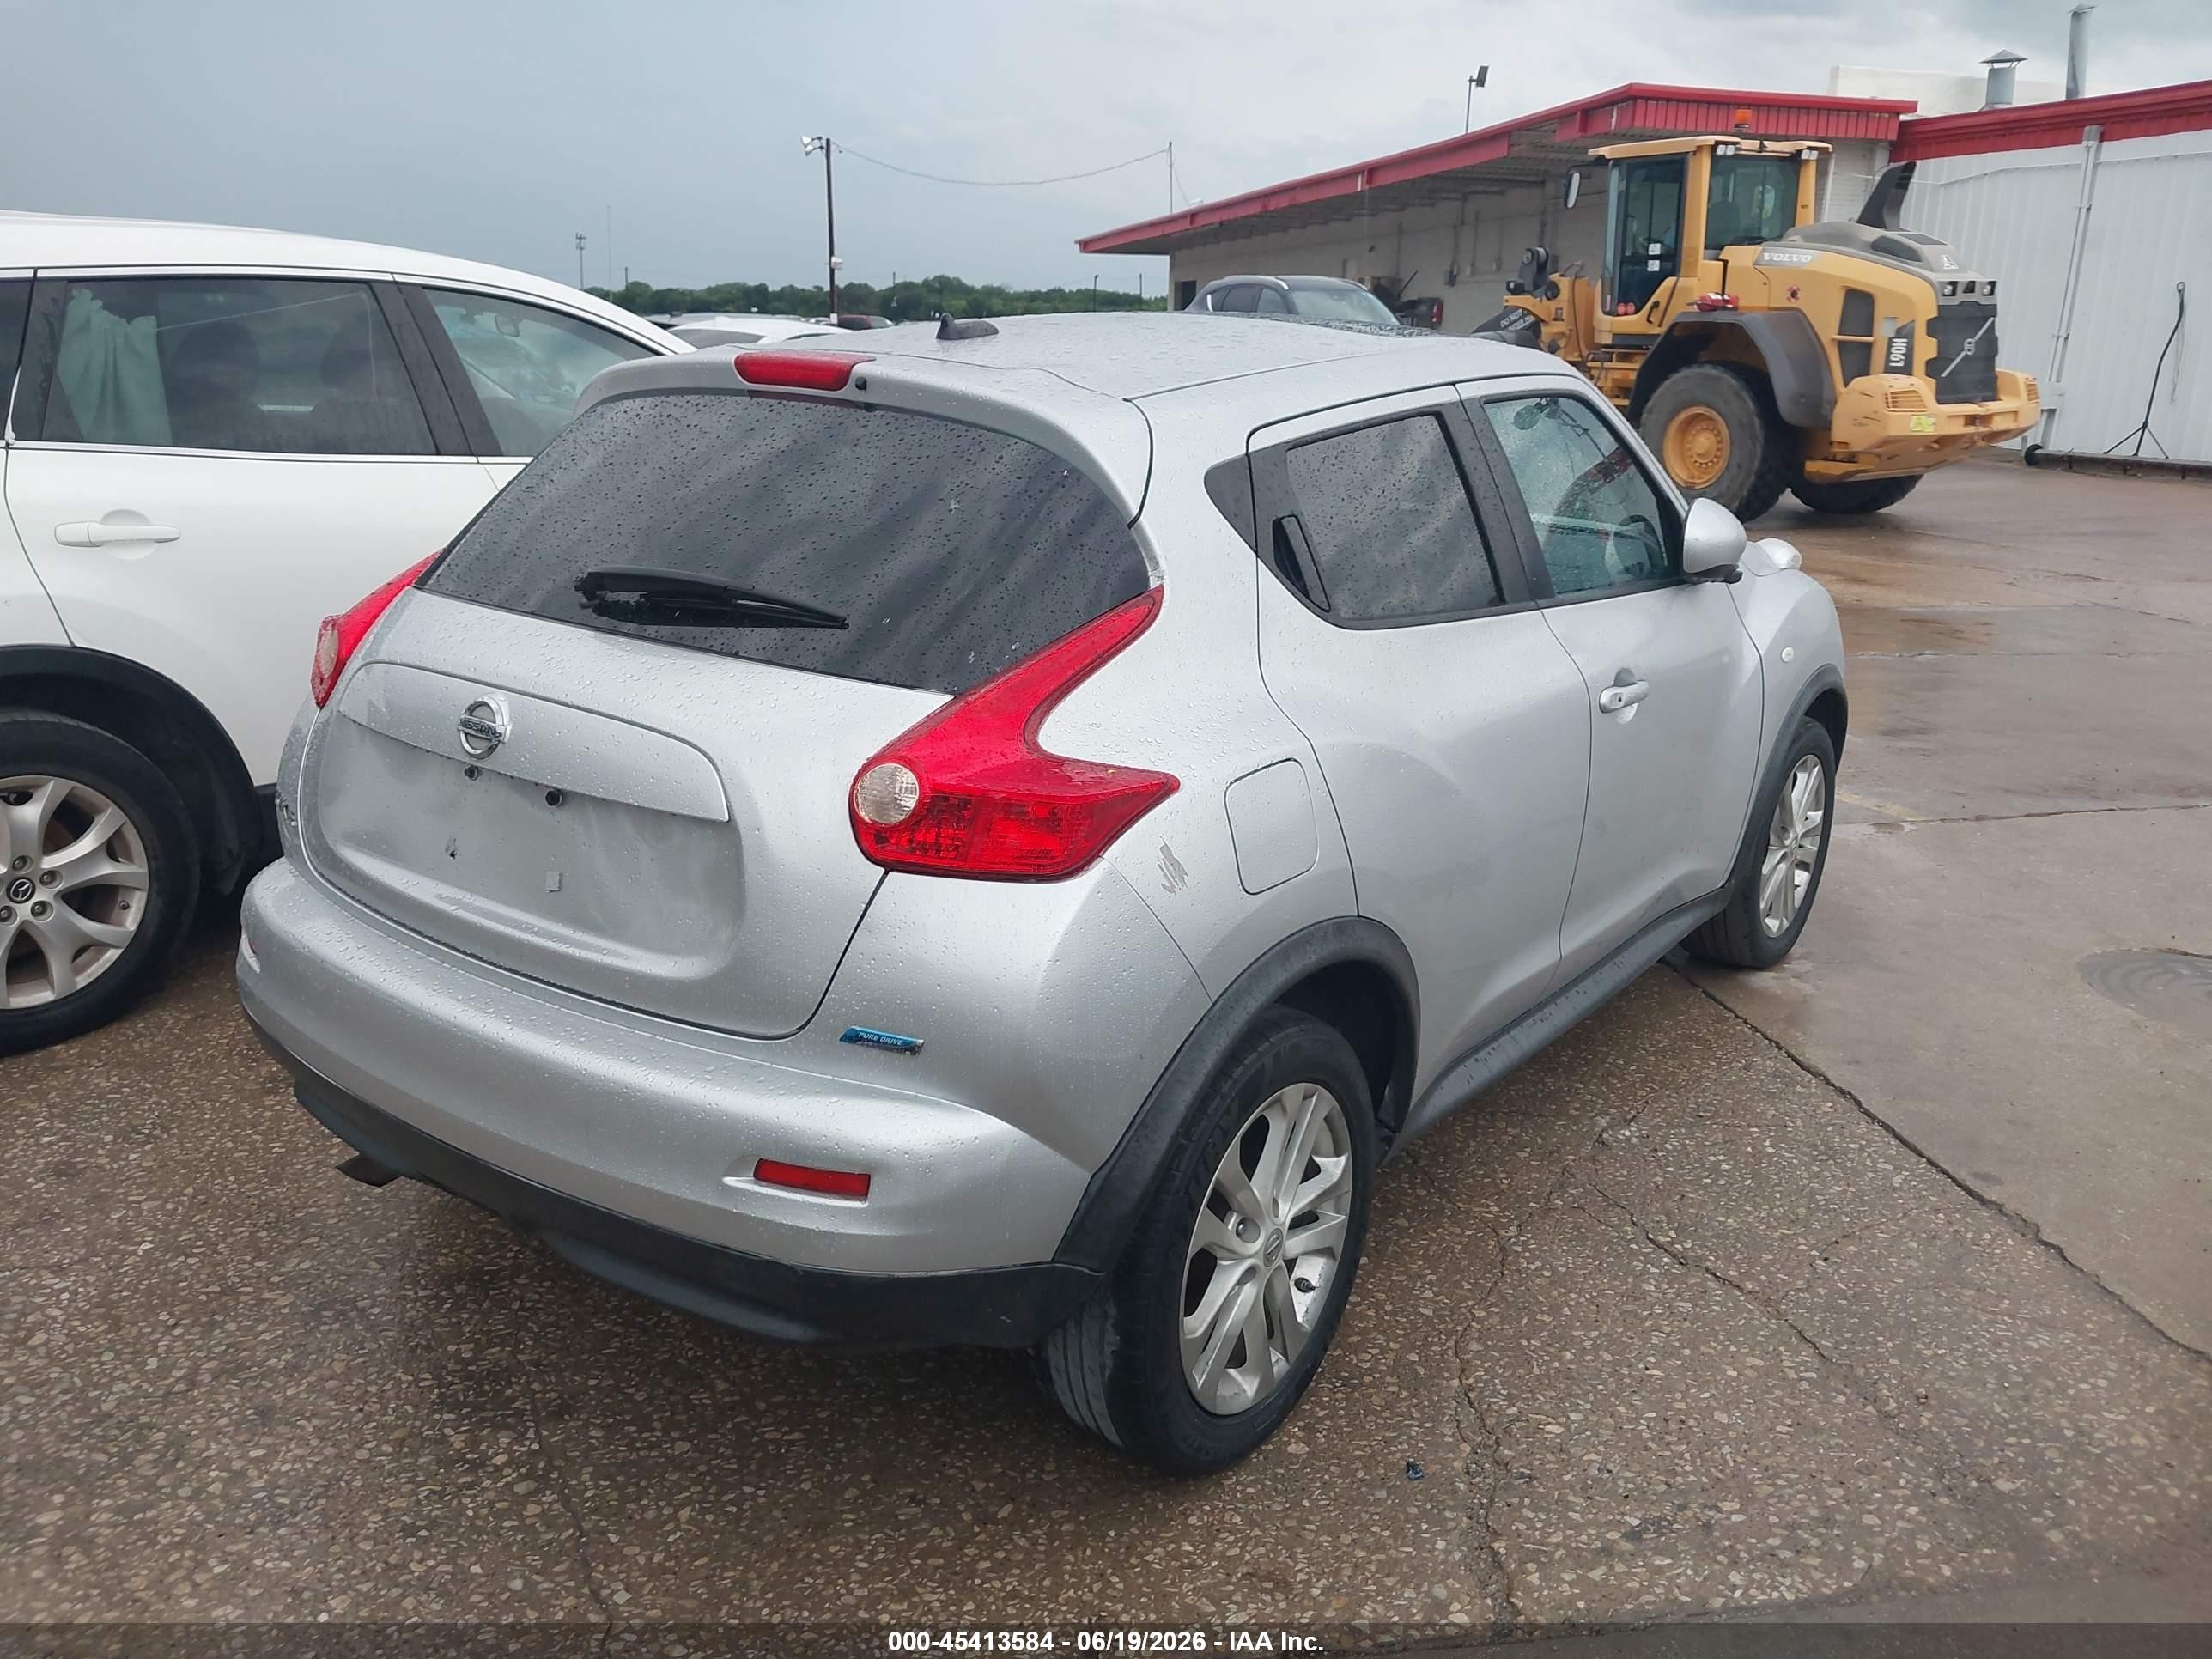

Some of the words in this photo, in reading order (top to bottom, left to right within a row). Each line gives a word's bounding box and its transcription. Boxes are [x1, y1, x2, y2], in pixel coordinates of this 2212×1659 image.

[1763, 252, 1813, 262] VOLVO
[1889, 338, 1908, 367] L90H
[461, 719, 496, 736] NISSAN
[859, 1032, 878, 1042] PURE
[879, 1036, 904, 1046] DRIVE
